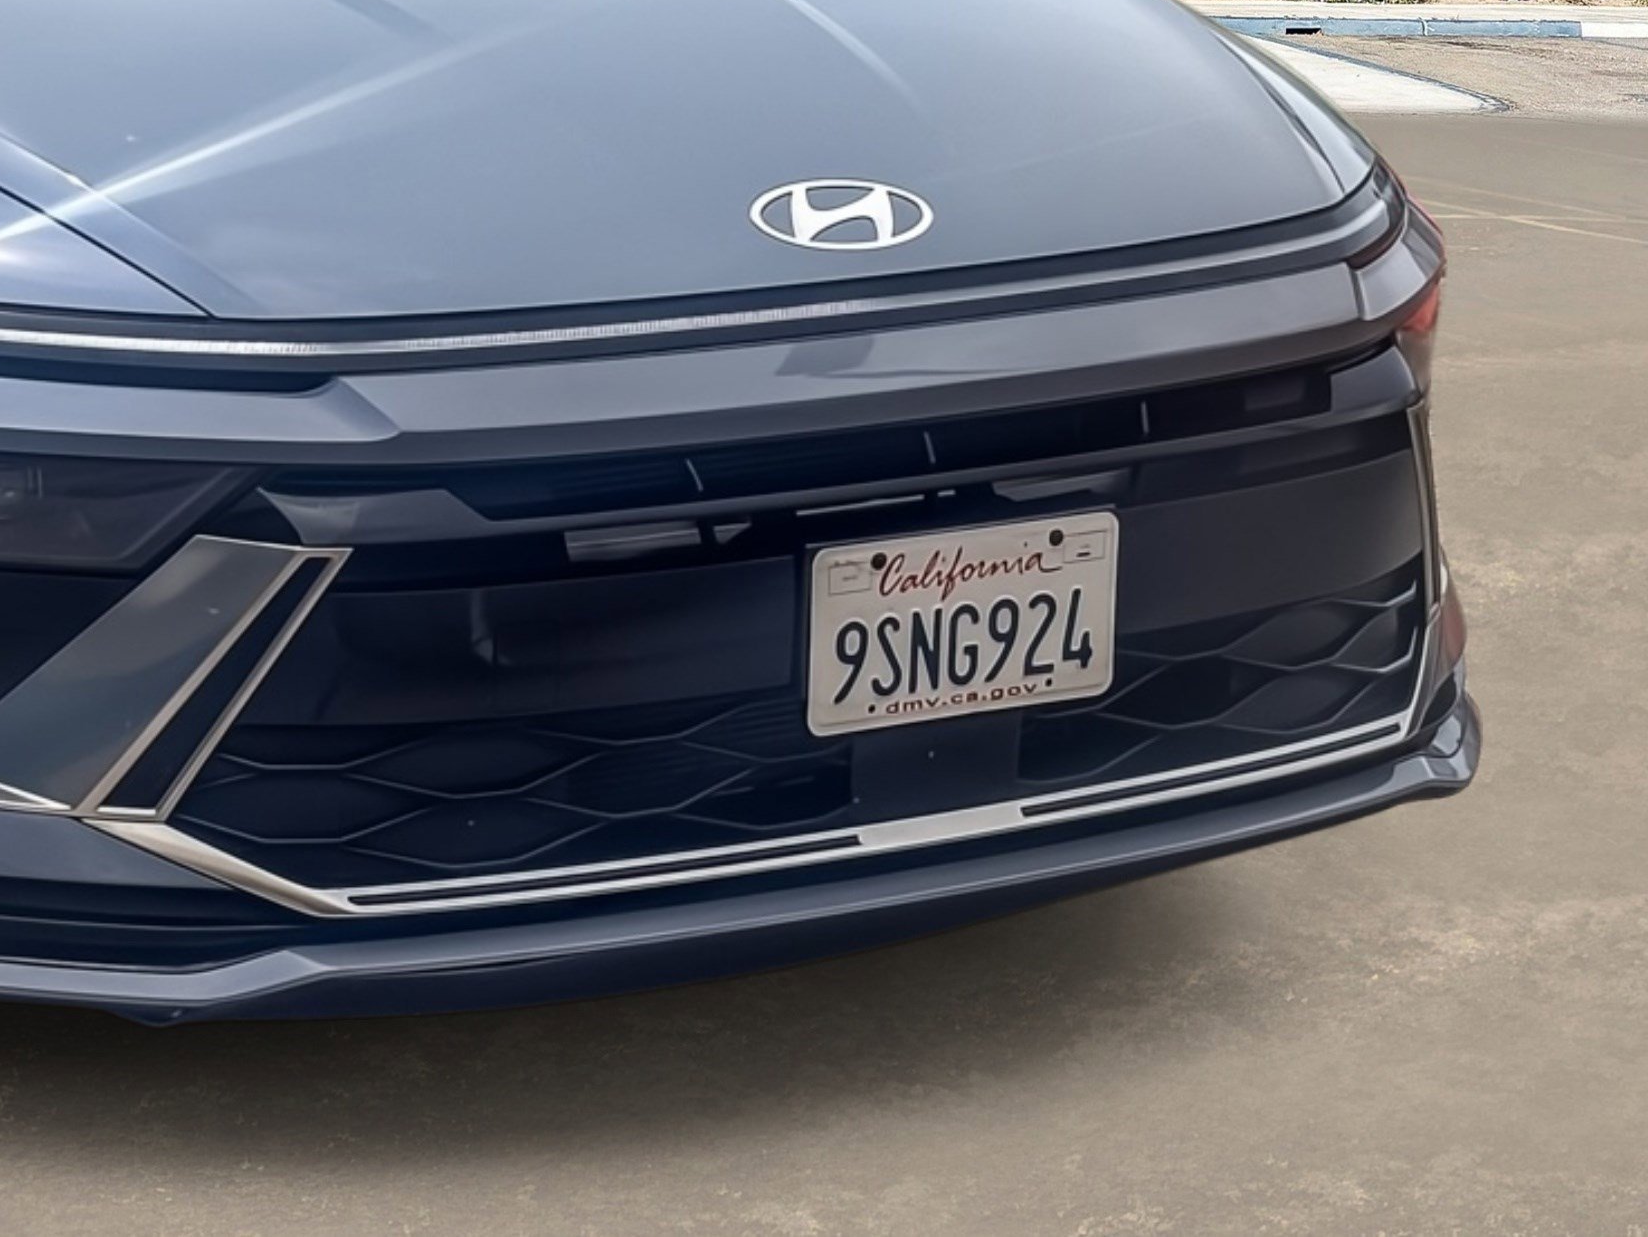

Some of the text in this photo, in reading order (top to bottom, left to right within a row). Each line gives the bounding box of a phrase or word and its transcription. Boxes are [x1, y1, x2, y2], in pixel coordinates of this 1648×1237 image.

[879, 542, 1063, 602] California
[833, 587, 1094, 706] 9SNG924
[884, 683, 1038, 715] dmv.ca.gov
